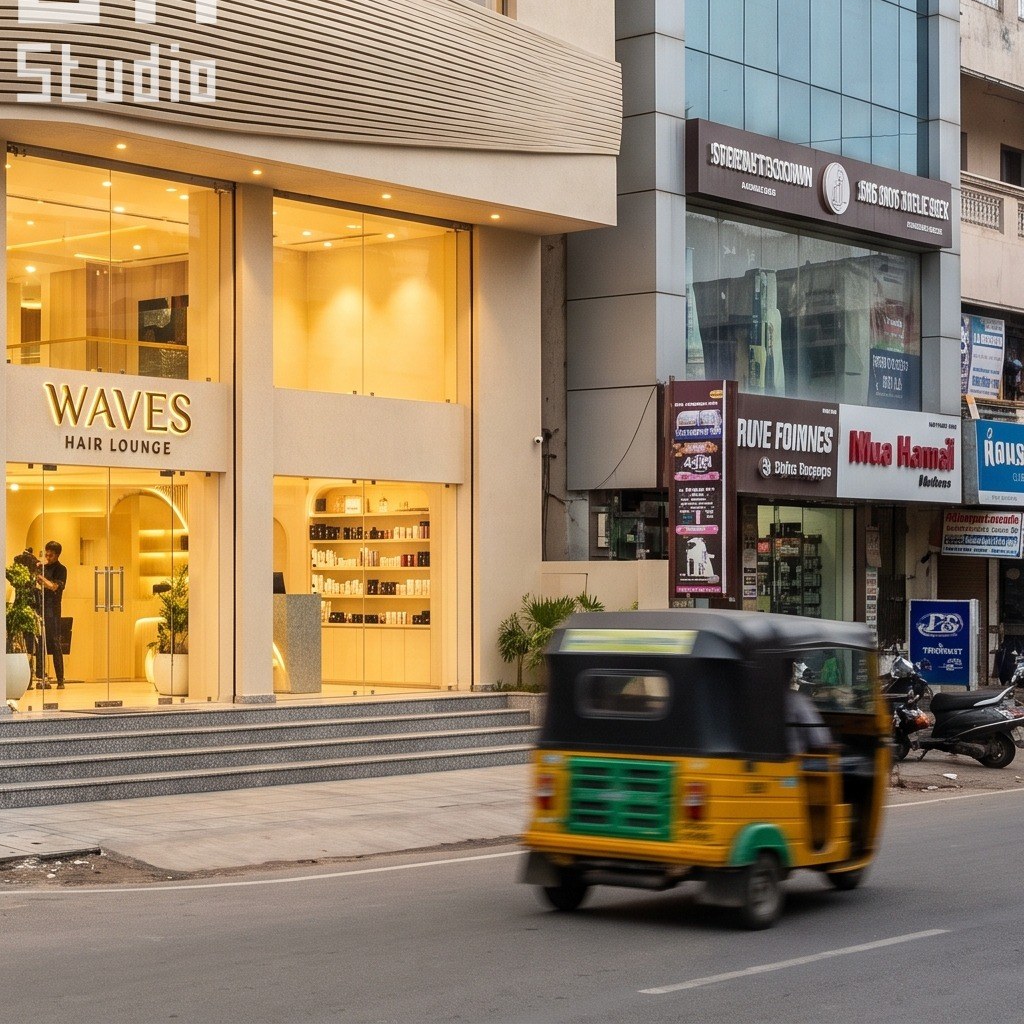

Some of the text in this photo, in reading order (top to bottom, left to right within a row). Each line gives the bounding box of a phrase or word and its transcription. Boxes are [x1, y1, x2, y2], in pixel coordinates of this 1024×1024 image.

[43, 382, 192, 435] WAVES
[65, 435, 171, 455] HAIR LOUNGE
